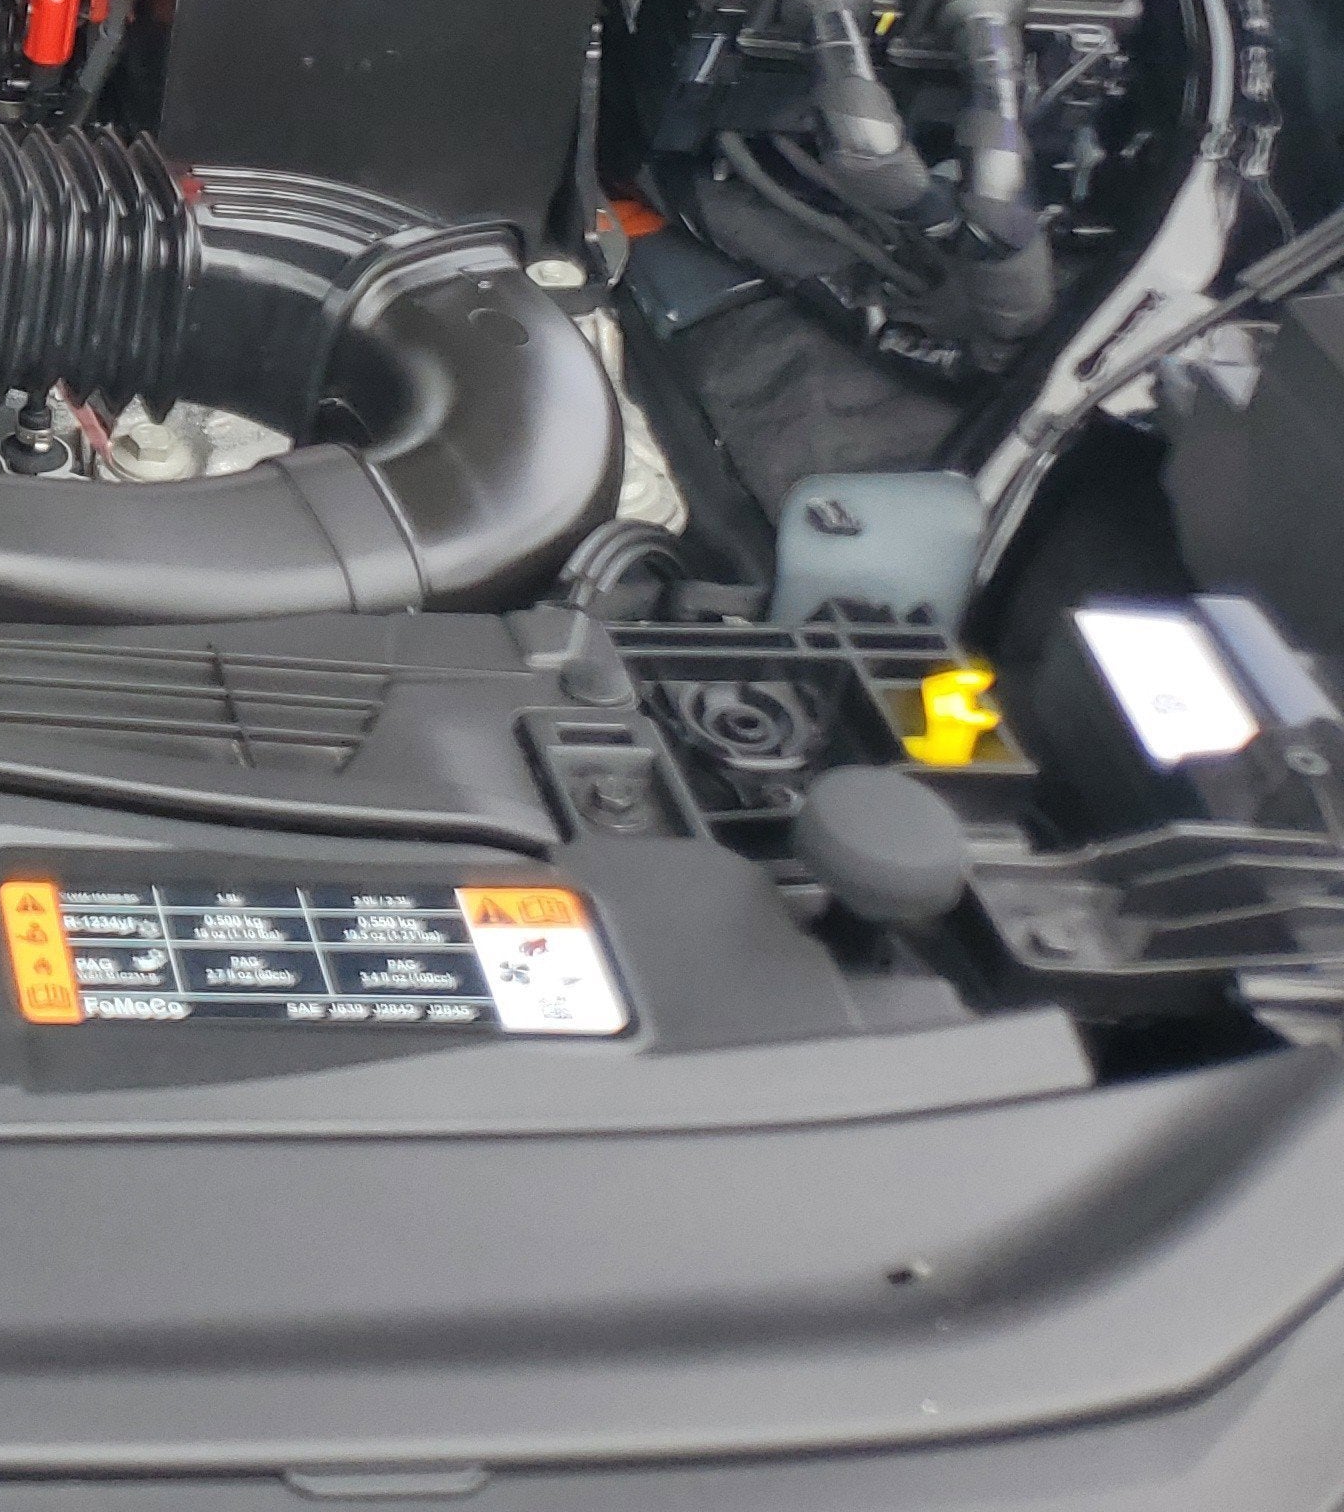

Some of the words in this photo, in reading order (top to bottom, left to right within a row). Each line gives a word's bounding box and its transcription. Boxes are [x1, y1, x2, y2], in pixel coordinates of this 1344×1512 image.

[63, 914, 134, 932] R-1234yf
[203, 913, 243, 927] 0.500
[243, 913, 264, 929] kg
[357, 915, 395, 929] 0.550
[397, 915, 417, 930] kg
[75, 958, 113, 972] PAG
[230, 955, 259, 967] PAG
[386, 959, 415, 970] PAG
[84, 996, 184, 1015] FoMoCo
[286, 1002, 321, 1014] SAE
[328, 1002, 364, 1014] J639
